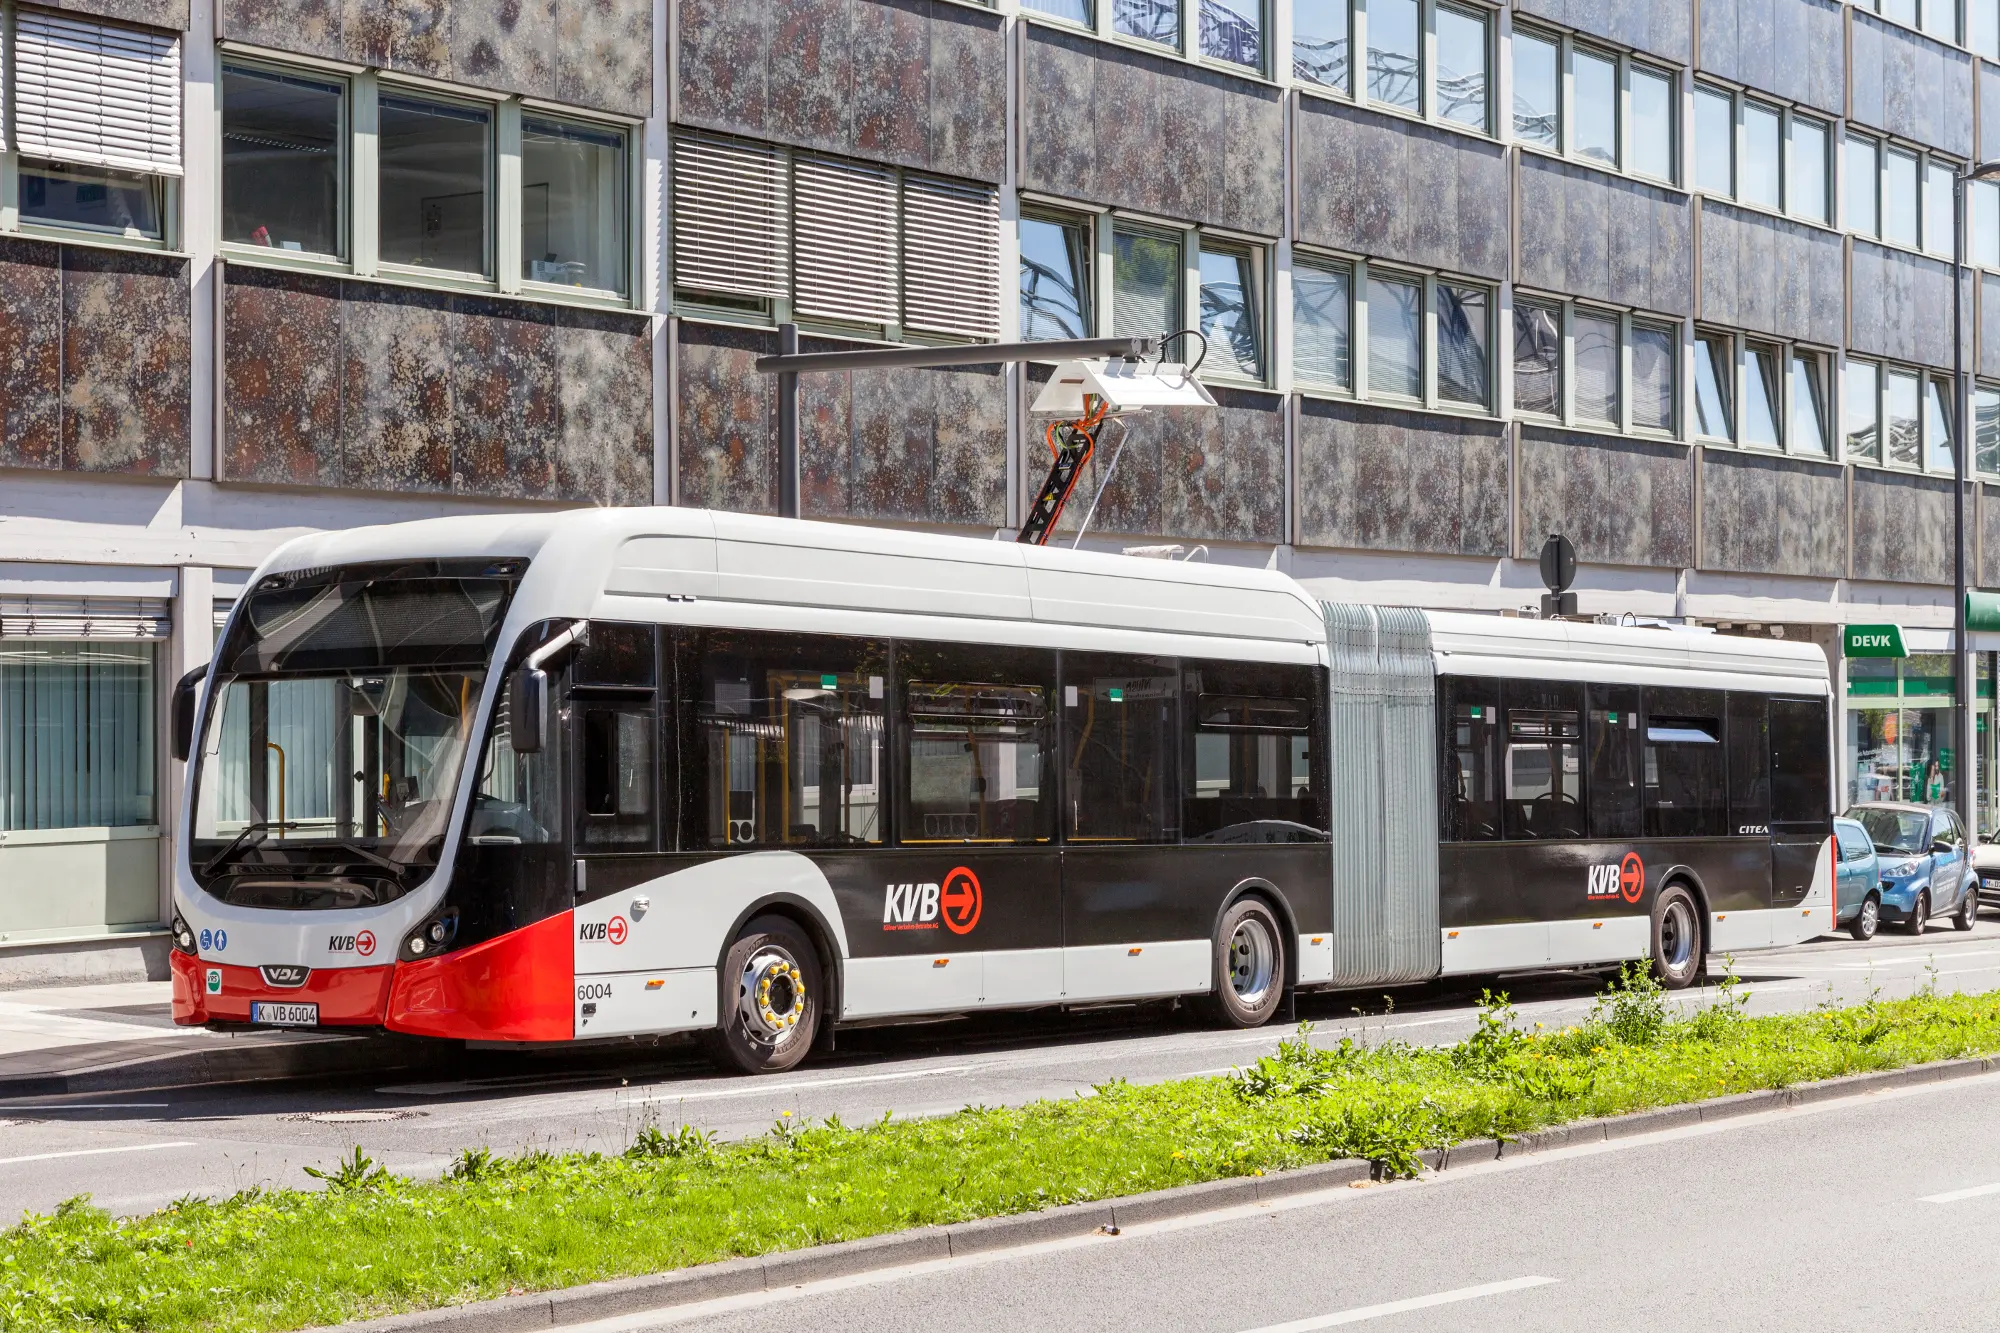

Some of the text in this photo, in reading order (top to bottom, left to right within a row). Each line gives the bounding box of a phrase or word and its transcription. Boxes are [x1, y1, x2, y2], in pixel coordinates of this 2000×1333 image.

[1852, 635, 1891, 647] DEVK
[1739, 825, 1769, 834] CITEA
[1587, 864, 1620, 894] KVB
[883, 883, 940, 923] KVB
[580, 923, 607, 940] KVB
[328, 935, 355, 951] KVB
[207, 975, 218, 983] VRS
[268, 968, 302, 981] VDL
[577, 983, 612, 1000] 6004
[258, 1005, 316, 1022] K VB 6004
